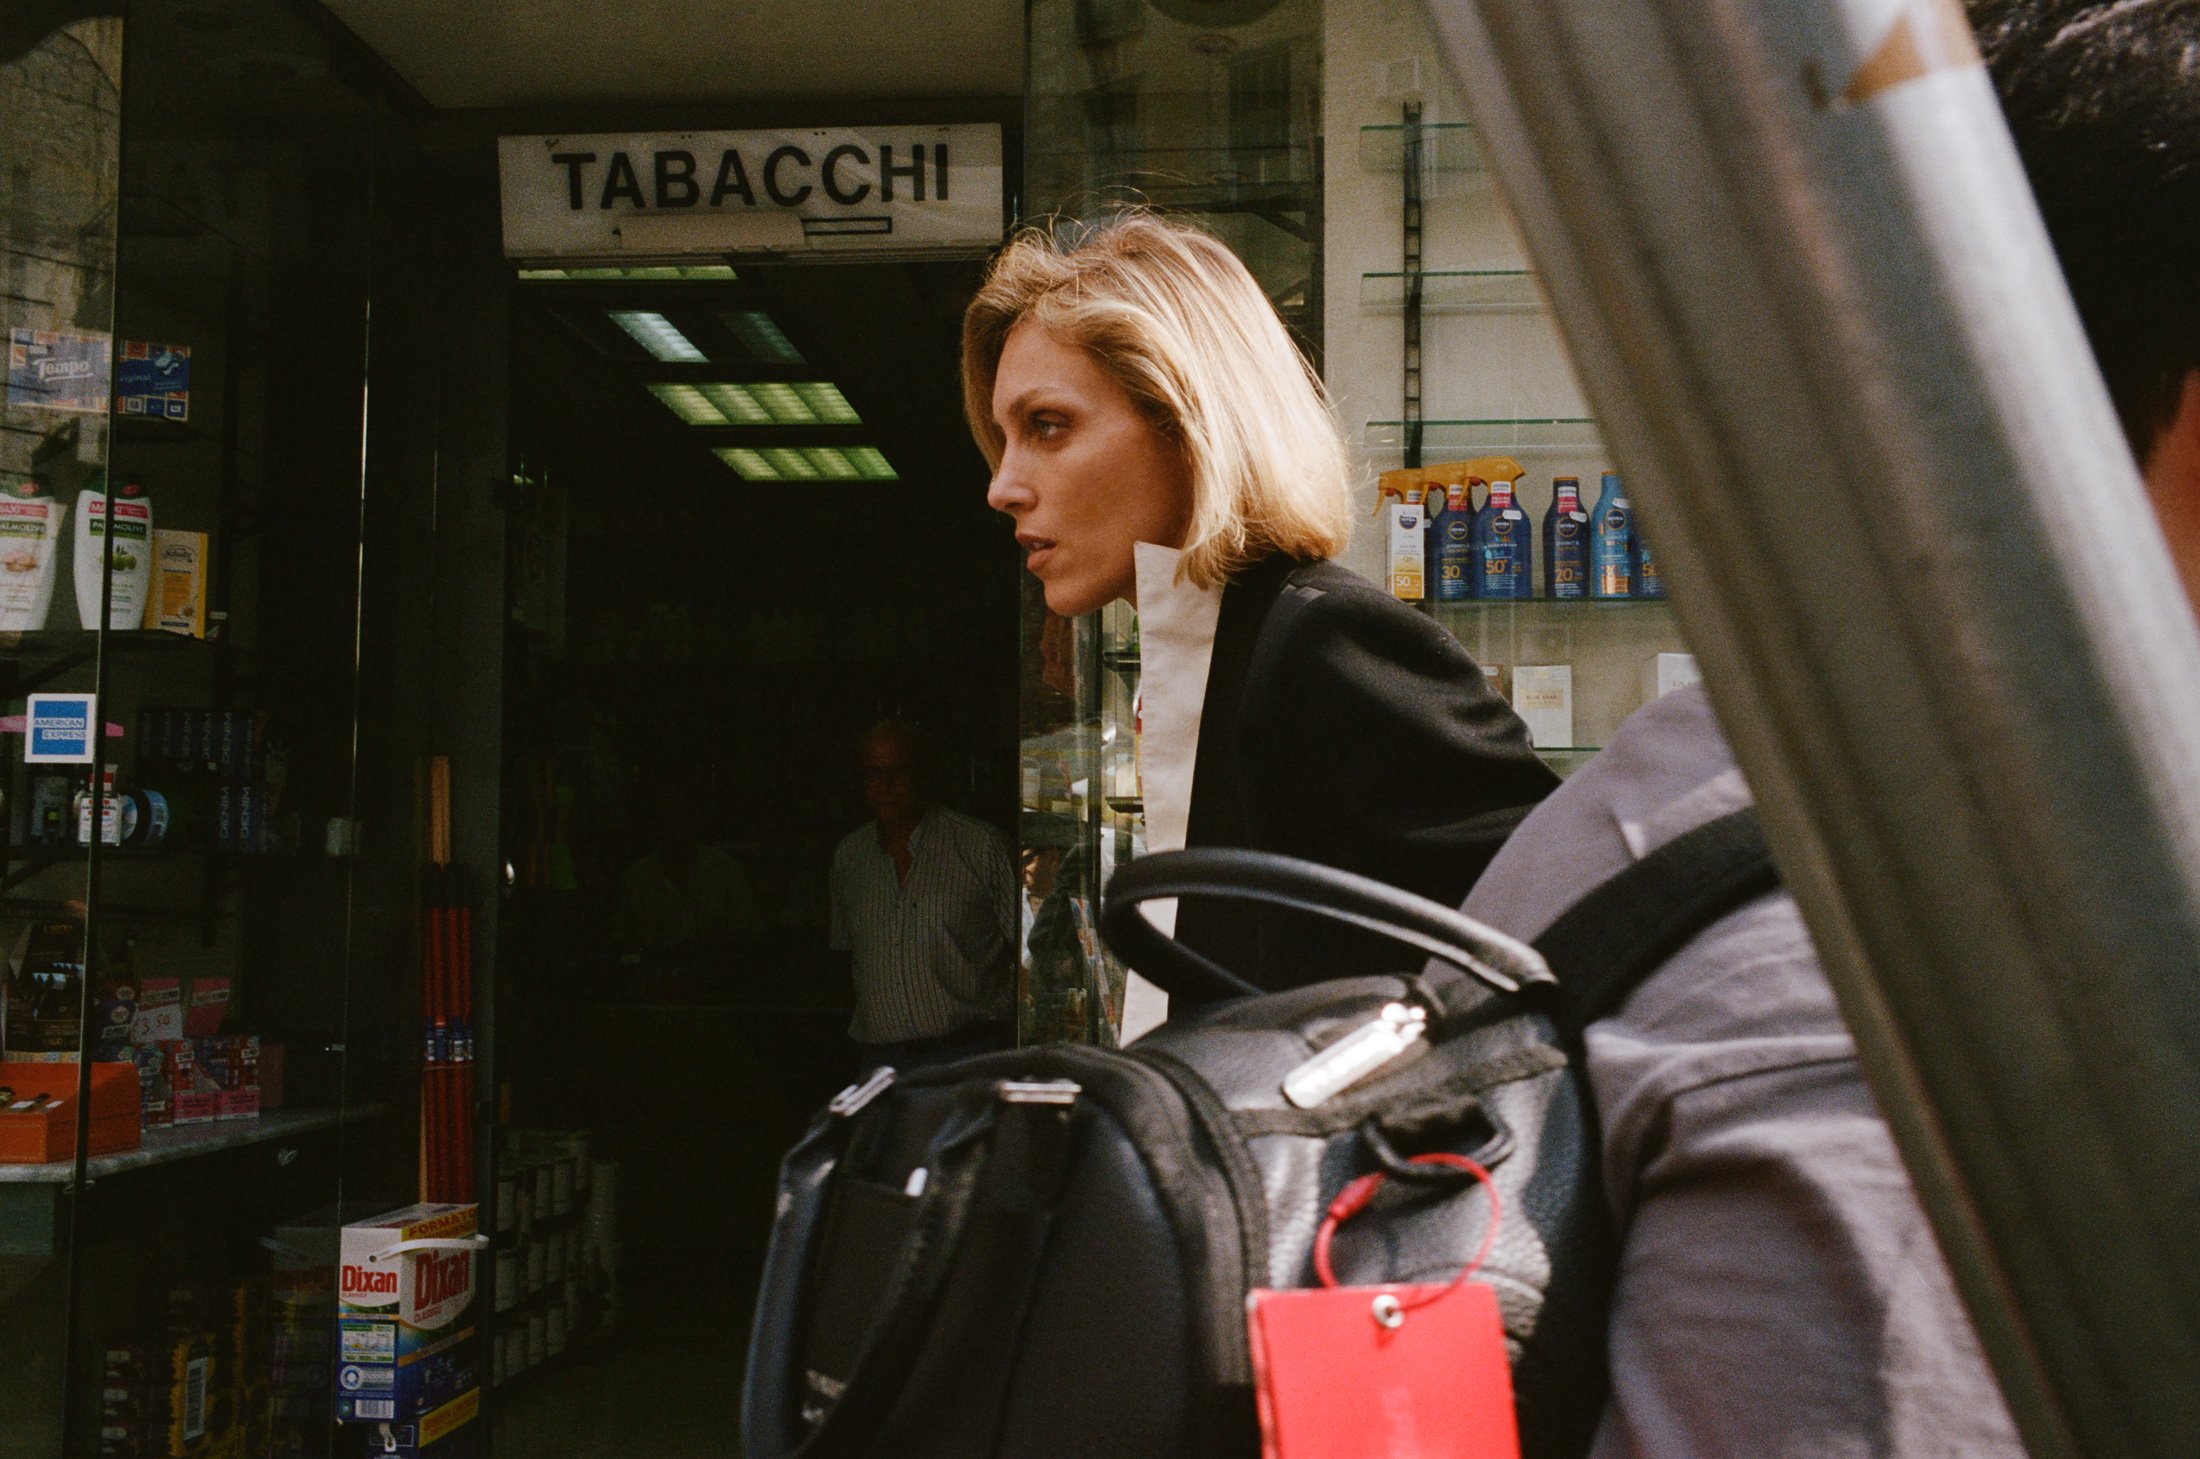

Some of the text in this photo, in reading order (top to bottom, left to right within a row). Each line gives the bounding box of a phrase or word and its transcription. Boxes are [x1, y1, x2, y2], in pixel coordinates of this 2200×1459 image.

[551, 143, 948, 210] TABACCHI
[32, 357, 91, 383] Tempo
[0, 523, 43, 533] ALMOLIVE
[92, 522, 146, 533] PAMOLIVE
[1396, 576, 1410, 587] 50
[1441, 565, 1460, 579] 30
[34, 719, 83, 728] AMERICAN
[44, 731, 87, 740] EXPRESS
[241, 786, 251, 840] DENIM
[409, 1207, 477, 1238] FORMATO
[342, 1265, 398, 1293] Dixan
[415, 1249, 471, 1312] Dixan
